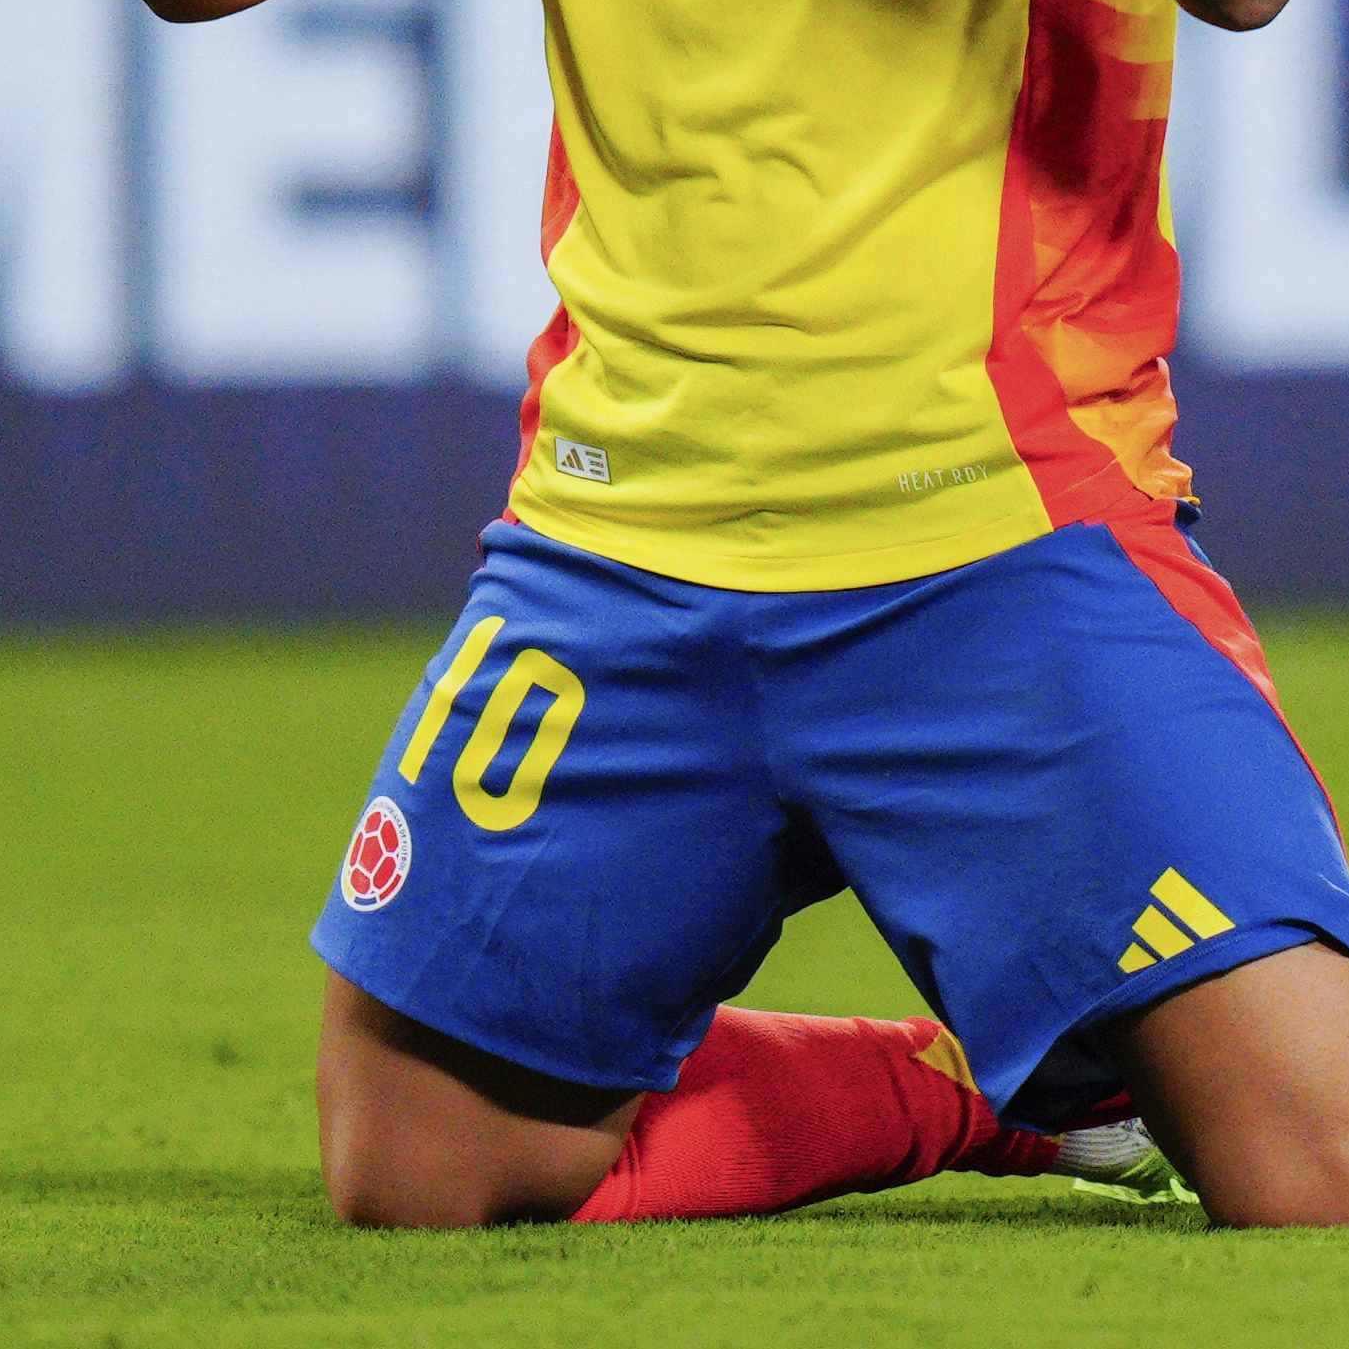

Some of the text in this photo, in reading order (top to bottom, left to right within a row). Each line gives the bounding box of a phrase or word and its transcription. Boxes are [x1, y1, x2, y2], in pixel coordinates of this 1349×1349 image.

[897, 464, 988, 493] HEAT RDY
[398, 615, 586, 832] 10
